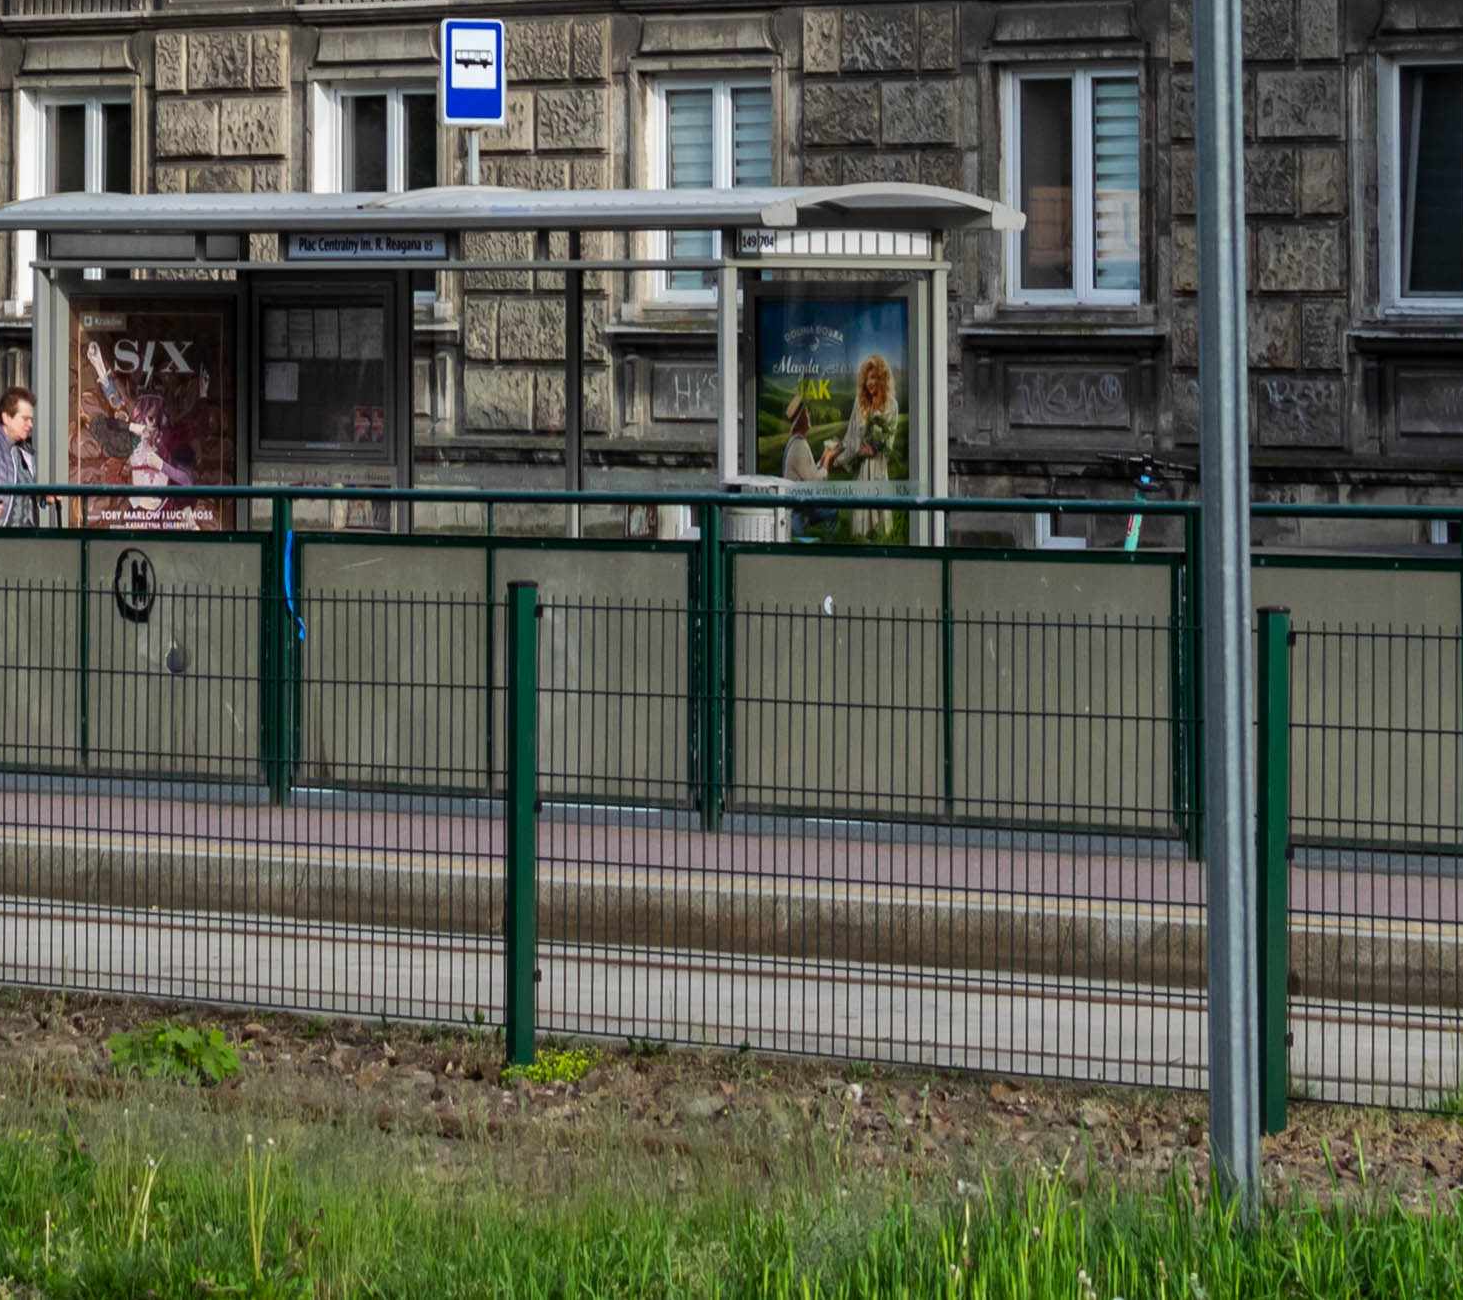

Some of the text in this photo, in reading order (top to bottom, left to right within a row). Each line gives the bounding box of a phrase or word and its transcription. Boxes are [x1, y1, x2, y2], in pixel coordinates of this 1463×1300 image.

[298, 237, 316, 251] Plac
[318, 237, 359, 254] Centralny
[386, 237, 422, 255] Reagana
[742, 234, 757, 249] 149
[759, 233, 775, 248] 704
[113, 338, 195, 385] SIX
[772, 354, 820, 380] Magda
[101, 511, 122, 520] TOBY
[123, 511, 161, 520] MARLOW
[166, 511, 187, 520] LUCY
[188, 511, 213, 520] MOSS
